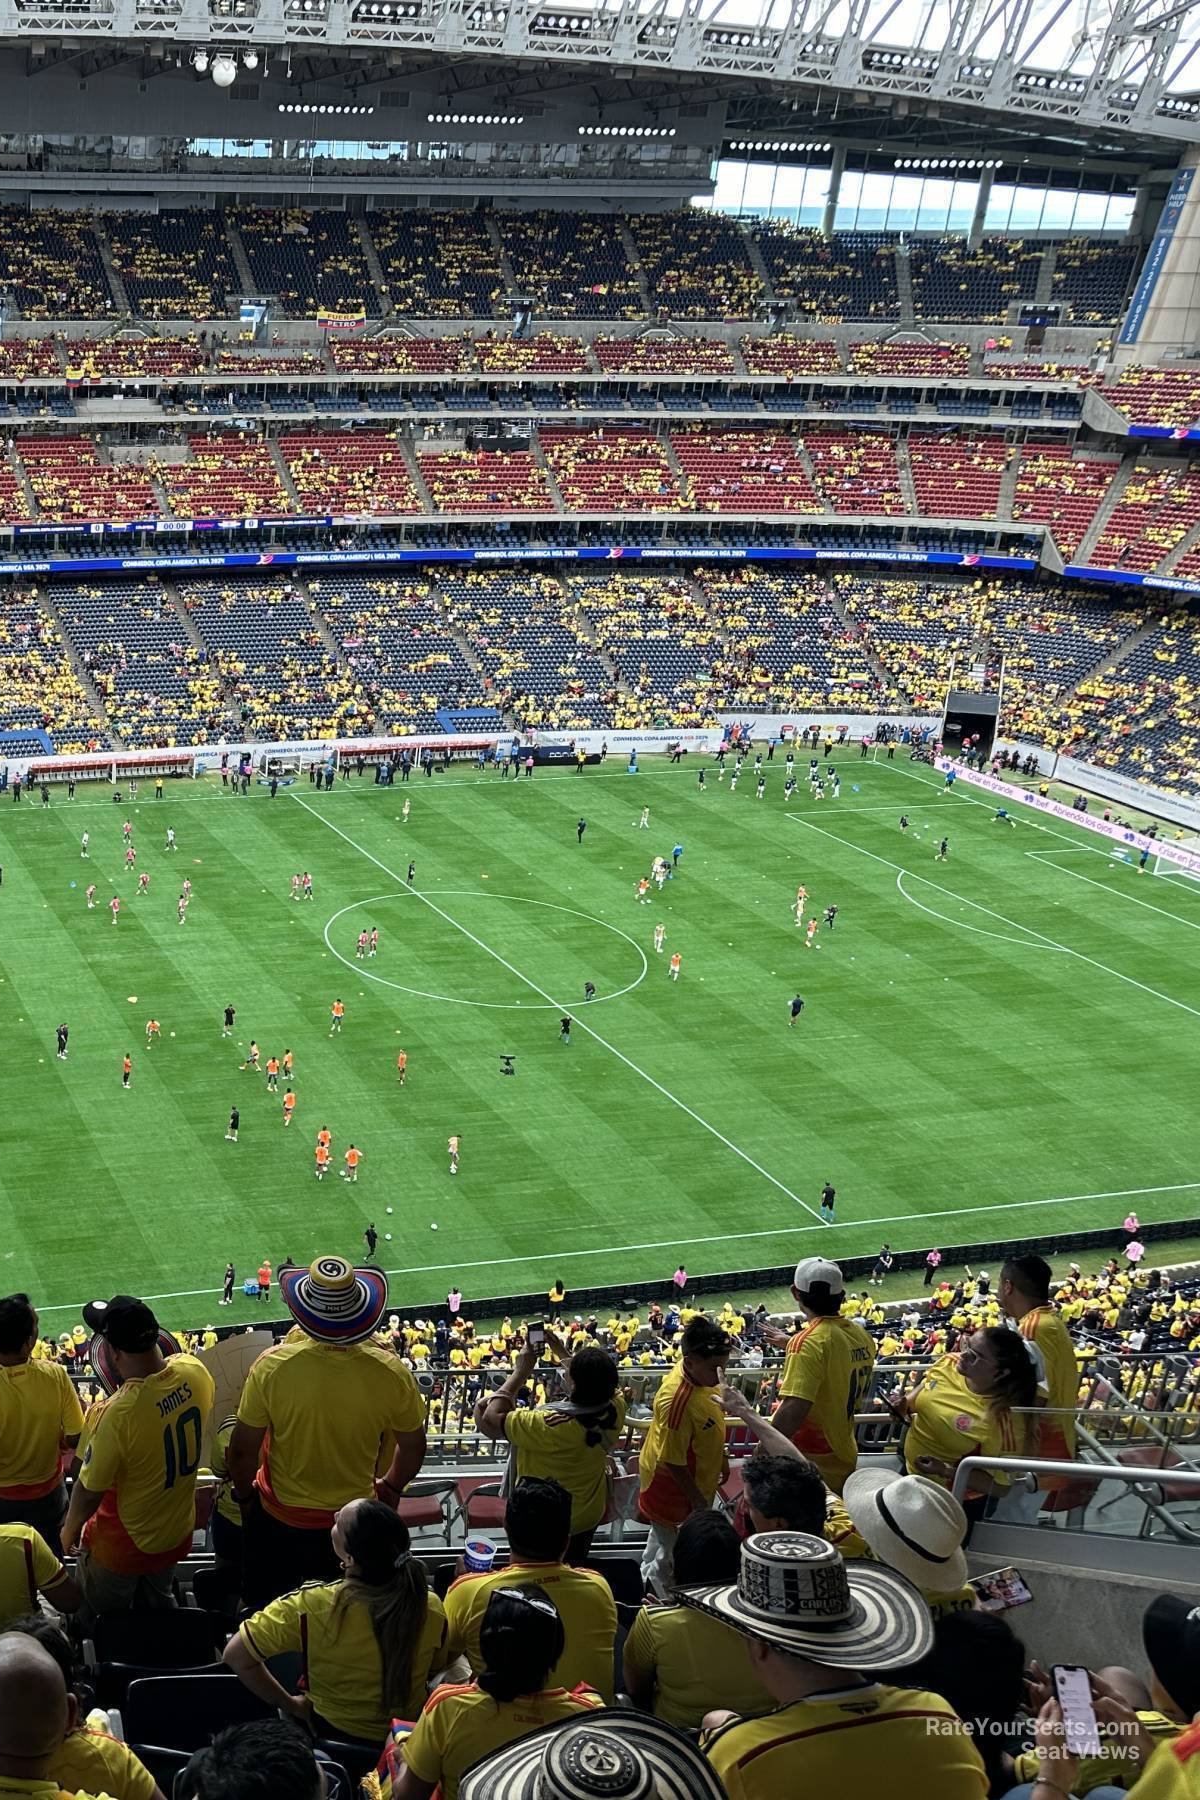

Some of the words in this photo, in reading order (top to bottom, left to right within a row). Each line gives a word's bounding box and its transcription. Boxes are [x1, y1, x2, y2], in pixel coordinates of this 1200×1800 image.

[967, 772, 982, 786] Criar
[982, 779, 992, 788] en
[991, 783, 1013, 796] grande
[1036, 799, 1049, 809] bef
[1053, 805, 1085, 824] Abriendo
[1085, 814, 1097, 828] los
[1096, 822, 1113, 835] ojos
[1158, 846, 1177, 859] Criar
[156, 1382, 193, 1418] JAMES
[163, 1406, 202, 1490] 10
